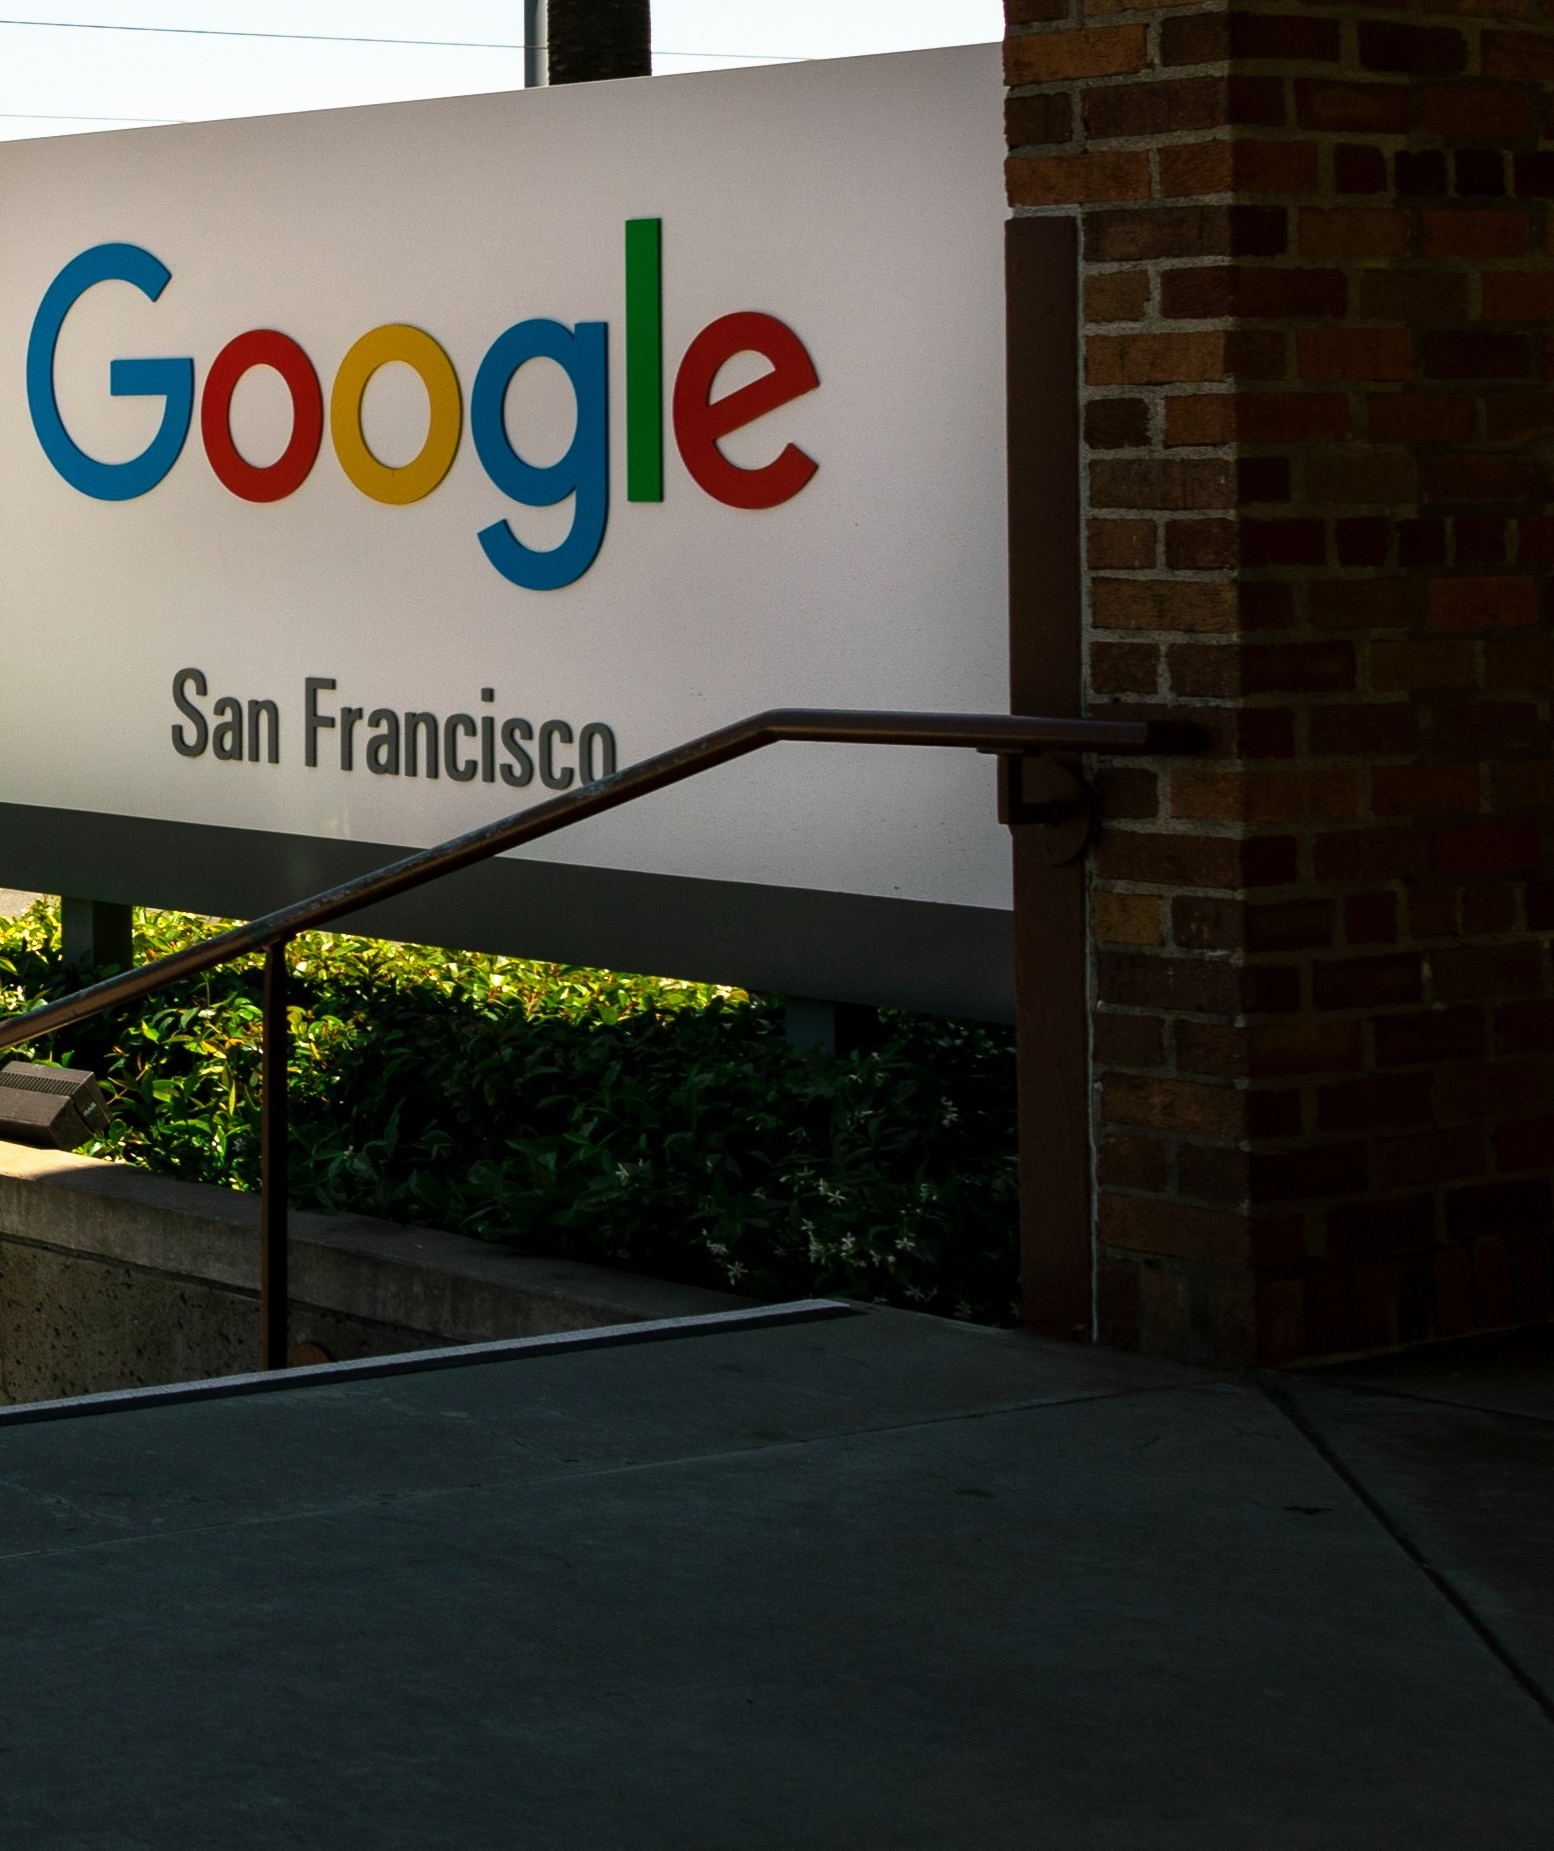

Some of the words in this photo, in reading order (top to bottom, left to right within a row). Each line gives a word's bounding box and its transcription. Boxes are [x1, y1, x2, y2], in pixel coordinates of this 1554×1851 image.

[26, 217, 820, 591] Google
[171, 667, 280, 765] San
[304, 676, 618, 791] Francisco
